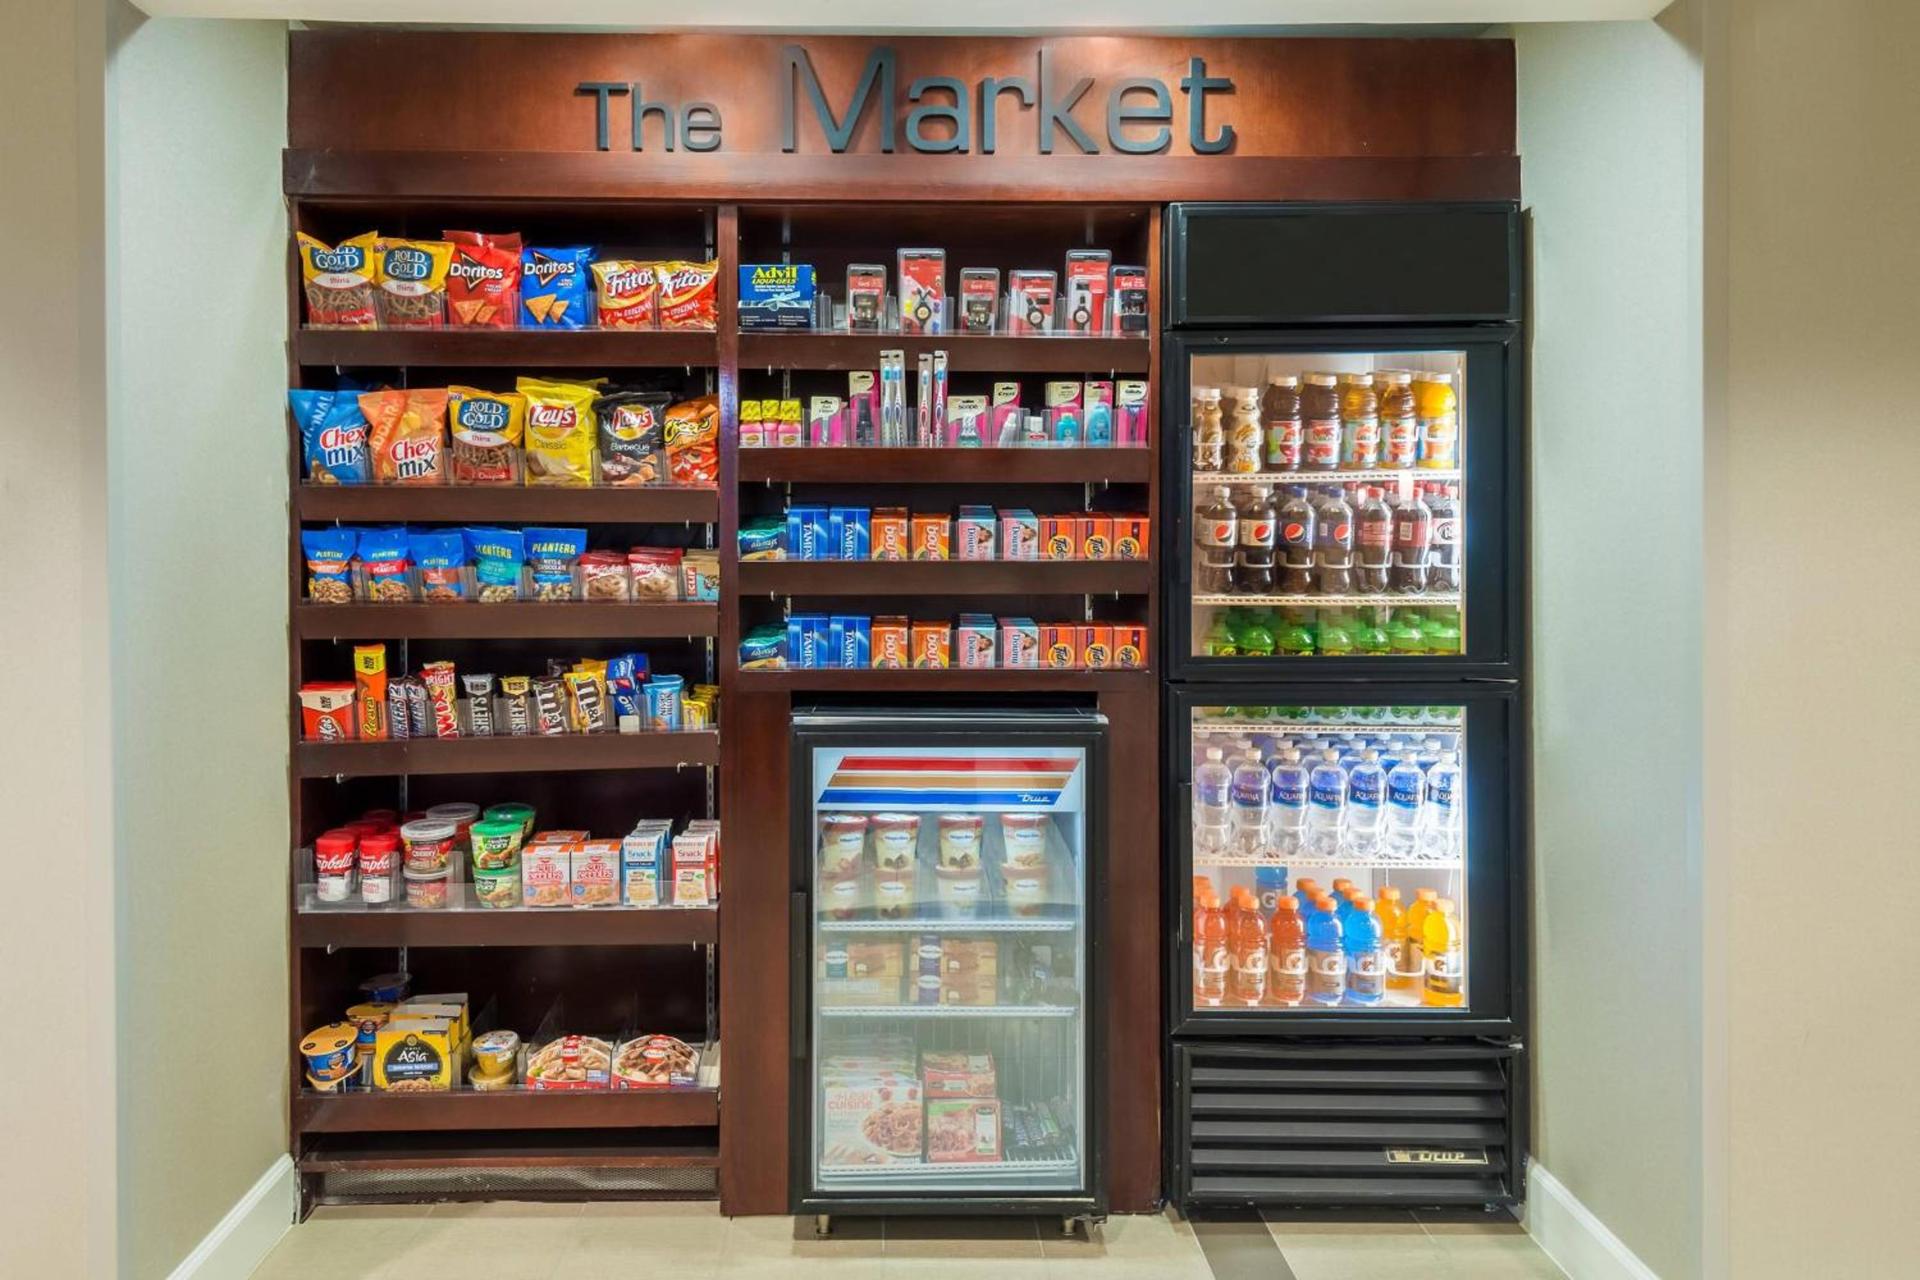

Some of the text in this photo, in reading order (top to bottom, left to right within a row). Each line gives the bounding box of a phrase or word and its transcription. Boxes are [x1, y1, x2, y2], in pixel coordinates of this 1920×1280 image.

[578, 45, 1234, 155] The Market
[316, 254, 360, 269] GOLD
[394, 250, 426, 263] ROLD
[388, 262, 428, 278] GOLD
[450, 263, 504, 279] Doritos
[524, 261, 575, 276] Doritos
[752, 266, 797, 279] Advil
[606, 269, 654, 297] Fritos
[469, 401, 502, 415] ROLD
[462, 413, 504, 429] GOLD
[529, 404, 576, 428] Lay's
[321, 425, 368, 449] Chex
[391, 437, 439, 462] Chex
[610, 441, 650, 451] Barbecue
[532, 541, 577, 555] PLANTERS
[628, 850, 653, 858] Snack
[677, 849, 703, 858] Snack
[1262, 892, 1277, 909] G
[397, 1050, 429, 1063] Asia
